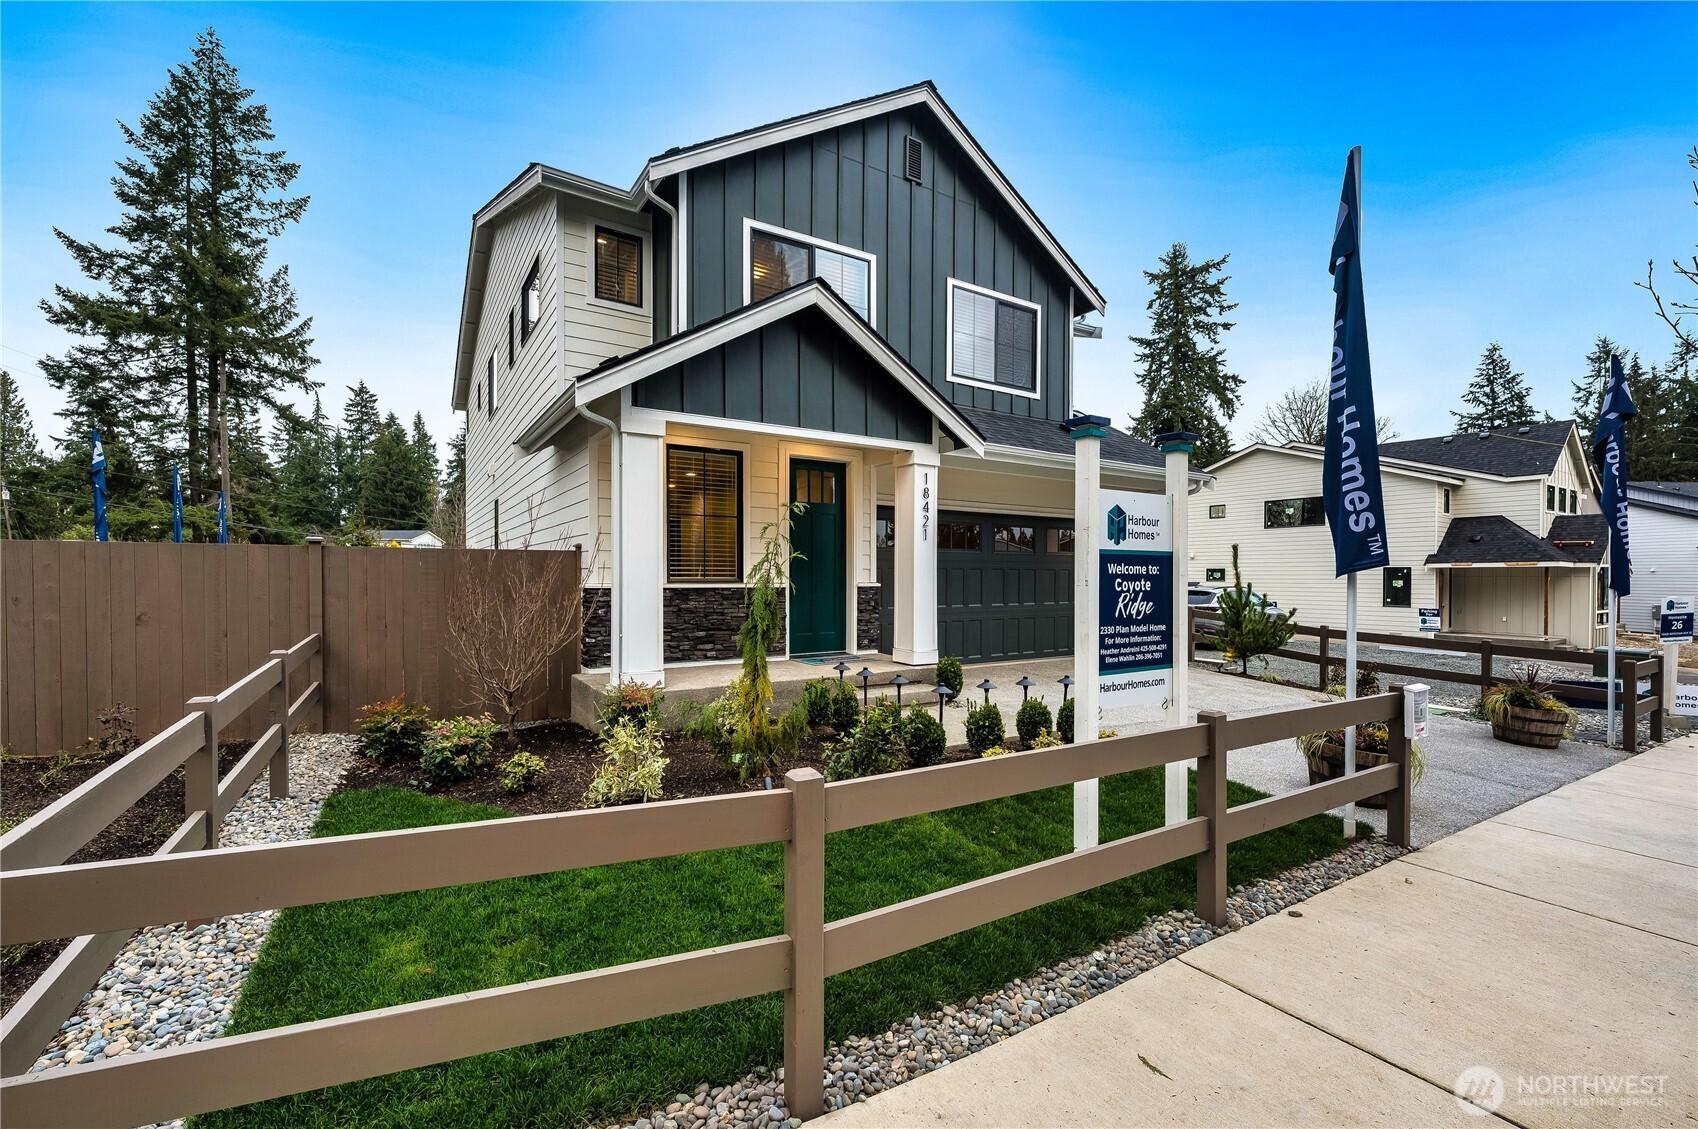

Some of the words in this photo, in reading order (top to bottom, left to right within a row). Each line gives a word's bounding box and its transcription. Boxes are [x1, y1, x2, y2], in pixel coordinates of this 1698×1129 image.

[922, 473, 930, 541] 18421
[1127, 515, 1160, 527] Harbour
[1127, 529, 1155, 541] Homes
[1107, 563, 1147, 575] Welcome
[1148, 565, 1160, 575] to:
[1114, 578, 1151, 594] Coyote
[1115, 592, 1155, 619] Ridge
[1100, 626, 1115, 635] 2330
[1115, 625, 1129, 633] Plan
[1130, 624, 1148, 632] Model
[1149, 624, 1167, 632] Home
[1671, 620, 1683, 630] 26
[1130, 634, 1161, 643] Information:
[1100, 678, 1166, 693] HarbourHomes.com
